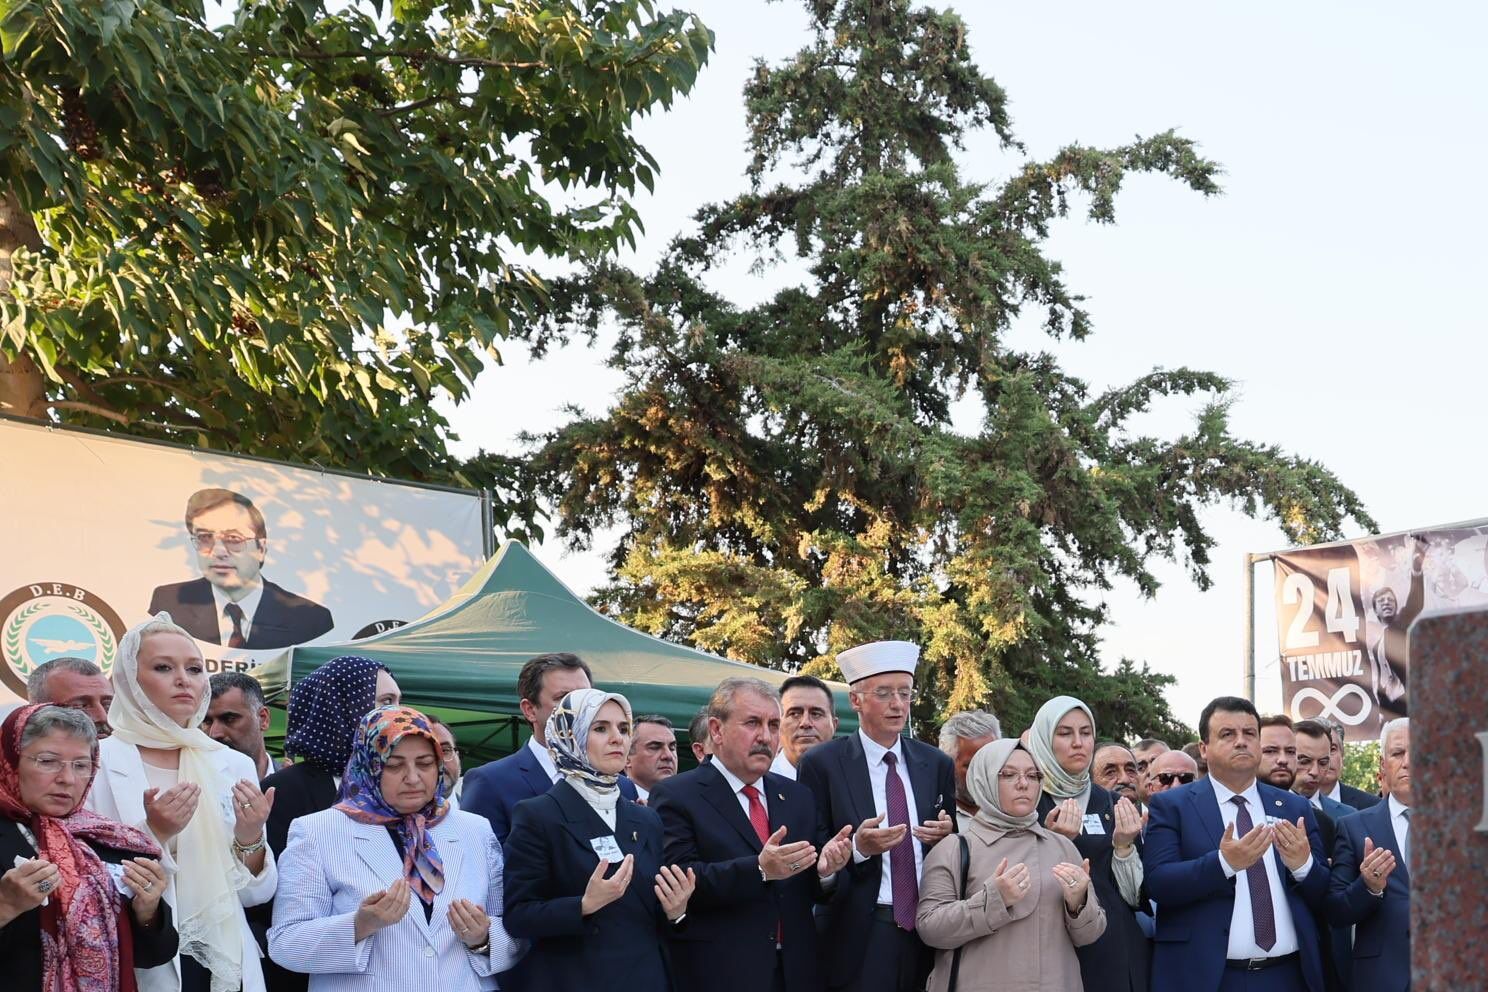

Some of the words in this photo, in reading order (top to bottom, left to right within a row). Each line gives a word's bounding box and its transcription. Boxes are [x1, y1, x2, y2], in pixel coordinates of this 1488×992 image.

[29, 583, 86, 601] D.E.B
[1282, 567, 1360, 650] 24
[1286, 650, 1364, 682] TEMMUZ
